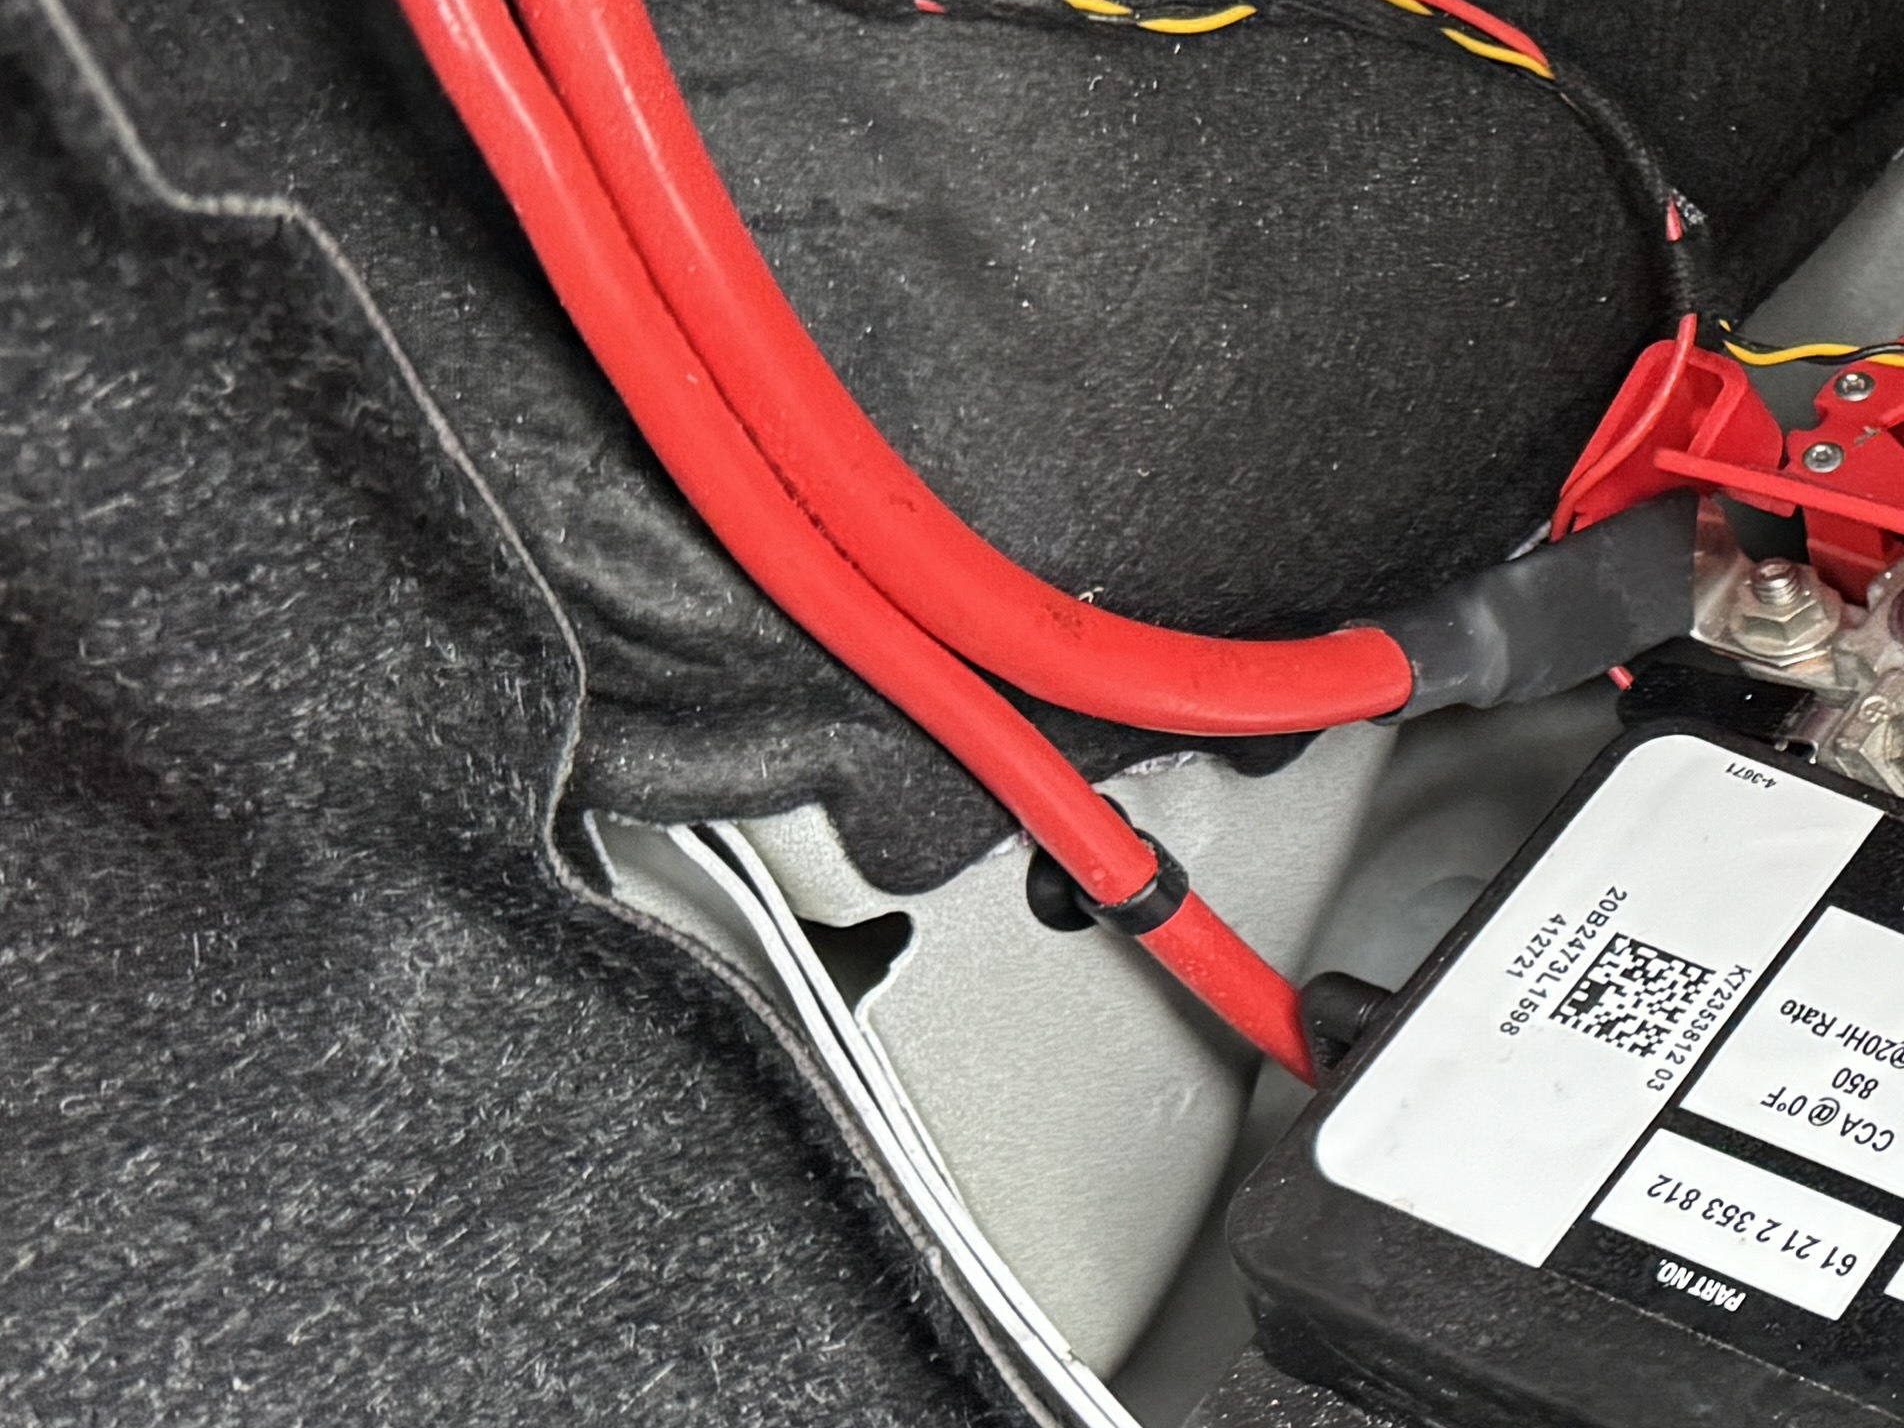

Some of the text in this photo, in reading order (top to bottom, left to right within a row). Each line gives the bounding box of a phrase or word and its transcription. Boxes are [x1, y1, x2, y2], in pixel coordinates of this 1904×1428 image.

[1499, 885, 1627, 1035] 20B2473L1598
[1505, 913, 1566, 978] 412721
[1645, 964, 1752, 1092] K72353812 03
[1779, 998, 1837, 1037] Rate
[1831, 1066, 1879, 1100] 850
[1759, 1085, 1895, 1152] CCA @ 0°F
[1646, 1173, 1857, 1277] 61 21 2 353 812
[1656, 1258, 1746, 1312] PART NO.
